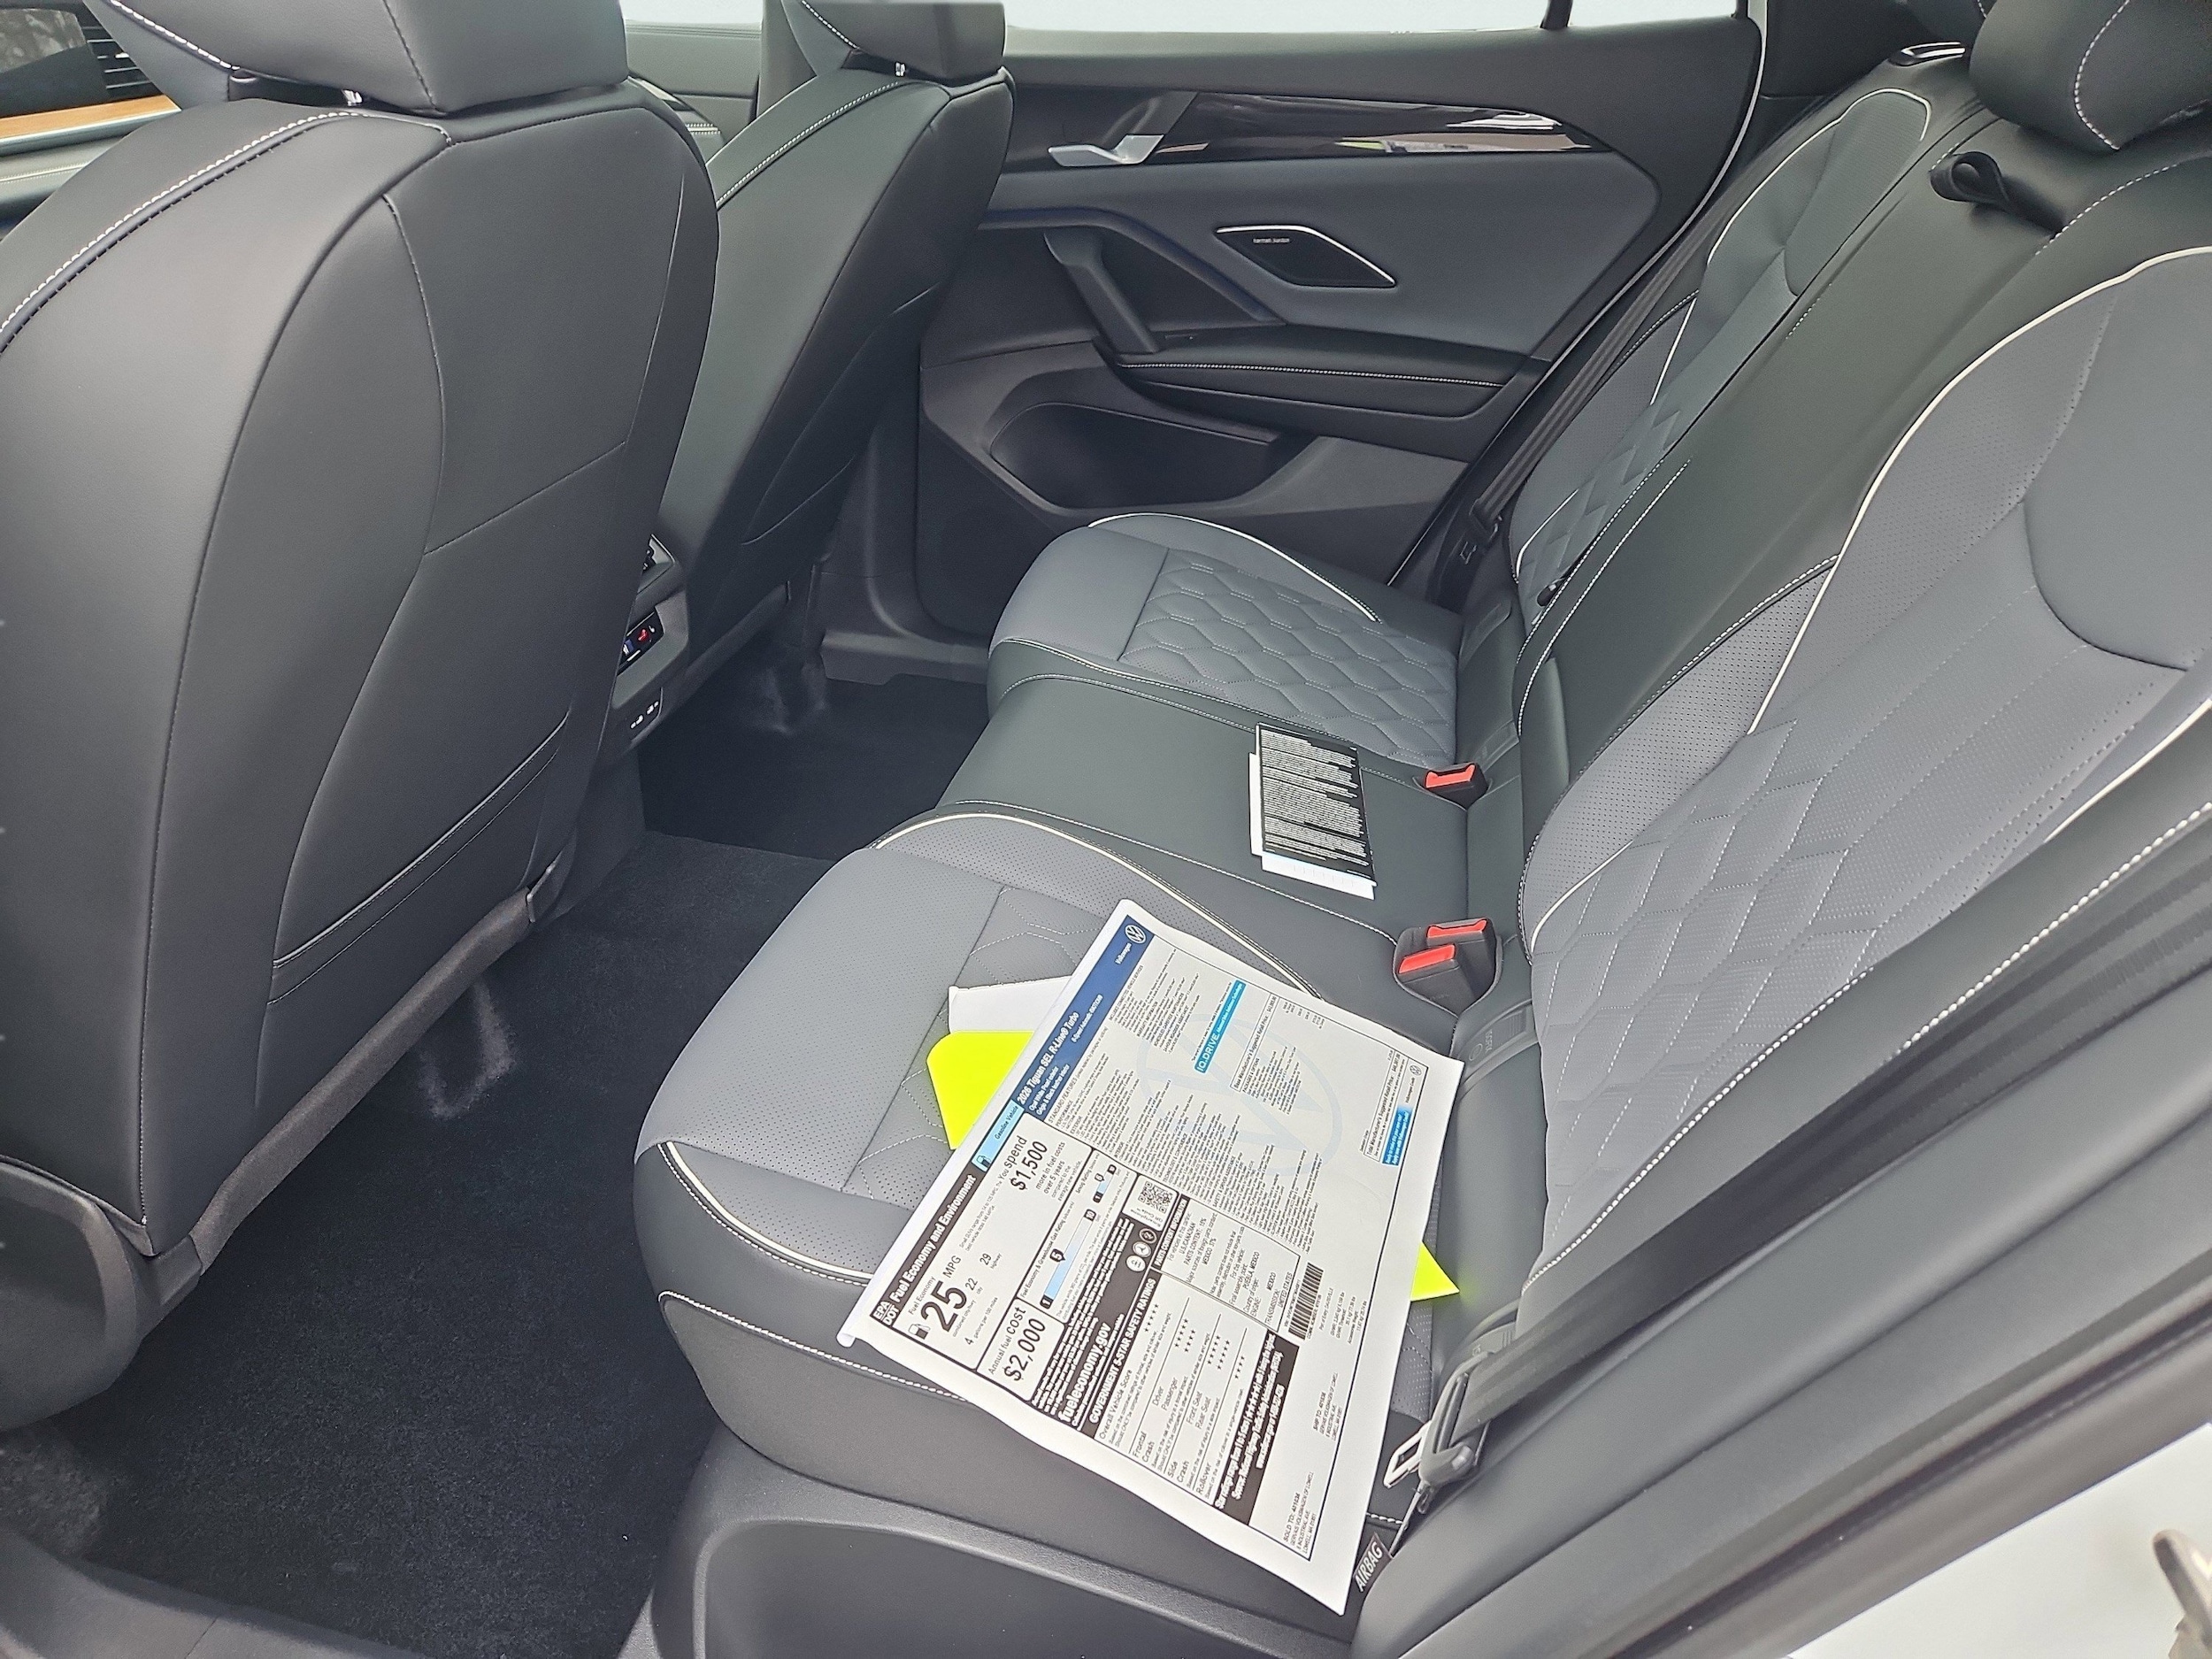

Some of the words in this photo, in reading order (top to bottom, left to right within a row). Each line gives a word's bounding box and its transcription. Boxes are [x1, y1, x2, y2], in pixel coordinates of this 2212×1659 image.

[1114, 942, 1132, 964] Volkswagen
[1016, 1085, 1033, 1105] 2026
[1025, 1065, 1046, 1088] Tiguan
[1040, 1052, 1055, 1067] SEL
[1063, 1011, 1079, 1030] Turbo
[1196, 1032, 1220, 1071] IQ.DRIVE
[1047, 1098, 1065, 1124] STANDARD
[1061, 1076, 1078, 1101] FEATURES
[994, 1120, 1010, 1140] Gasoline
[1005, 1104, 1019, 1121] Vehicle
[1002, 1134, 1028, 1169] spend
[1010, 1141, 1048, 1191] $1,500
[1034, 1173, 1048, 1190] more
[1041, 1166, 1051, 1175] in
[1046, 1155, 1057, 1168] fuel
[1053, 1141, 1066, 1157] costs
[997, 1168, 1010, 1180] You
[1042, 1179, 1054, 1194] over
[1052, 1160, 1065, 1177] years
[937, 1174, 976, 1225] Environment
[929, 1223, 946, 1242] and
[902, 1240, 936, 1282] Economy
[941, 1255, 962, 1279] MPG
[979, 1252, 992, 1266] 29
[1019, 1286, 1029, 1298] Fuel
[1049, 1232, 1058, 1241] Gas
[1182, 1248, 1194, 1265] PARTS
[889, 1279, 910, 1302] Fuel
[907, 1300, 920, 1316] Fuel
[915, 1275, 936, 1302] Economy
[964, 1277, 979, 1291] 22
[1282, 1271, 1293, 1291] STATES
[872, 1301, 890, 1319] EPA
[882, 1304, 899, 1325] DOT
[919, 1279, 967, 1333] 25
[1005, 1306, 1026, 1335] cost
[964, 1337, 974, 1346] 4
[1000, 1334, 1012, 1349] fuel
[1003, 1317, 1046, 1381] $2,000
[1088, 1363, 1119, 1424] GOVERNMENT
[1112, 1337, 1132, 1366] 5-STAR
[1124, 1308, 1143, 1339] SAFETY
[1136, 1278, 1156, 1310] RATINGS
[987, 1348, 1005, 1375] Annual
[1057, 1322, 1111, 1423] fueleconomy.gov
[1098, 1412, 1114, 1440] Overall
[1109, 1388, 1125, 1413] Vehicle
[1119, 1369, 1133, 1389] Score
[1151, 1385, 1164, 1407] Driver
[1160, 1376, 1179, 1411] Passenger
[1131, 1430, 1147, 1458] Frontal
[1141, 1440, 1156, 1463] Crash
[1166, 1460, 1179, 1479] Side
[1176, 1460, 1190, 1483] Crash
[1194, 1462, 1211, 1495] Rollover
[1355, 1541, 1383, 1593] AIRBAG
